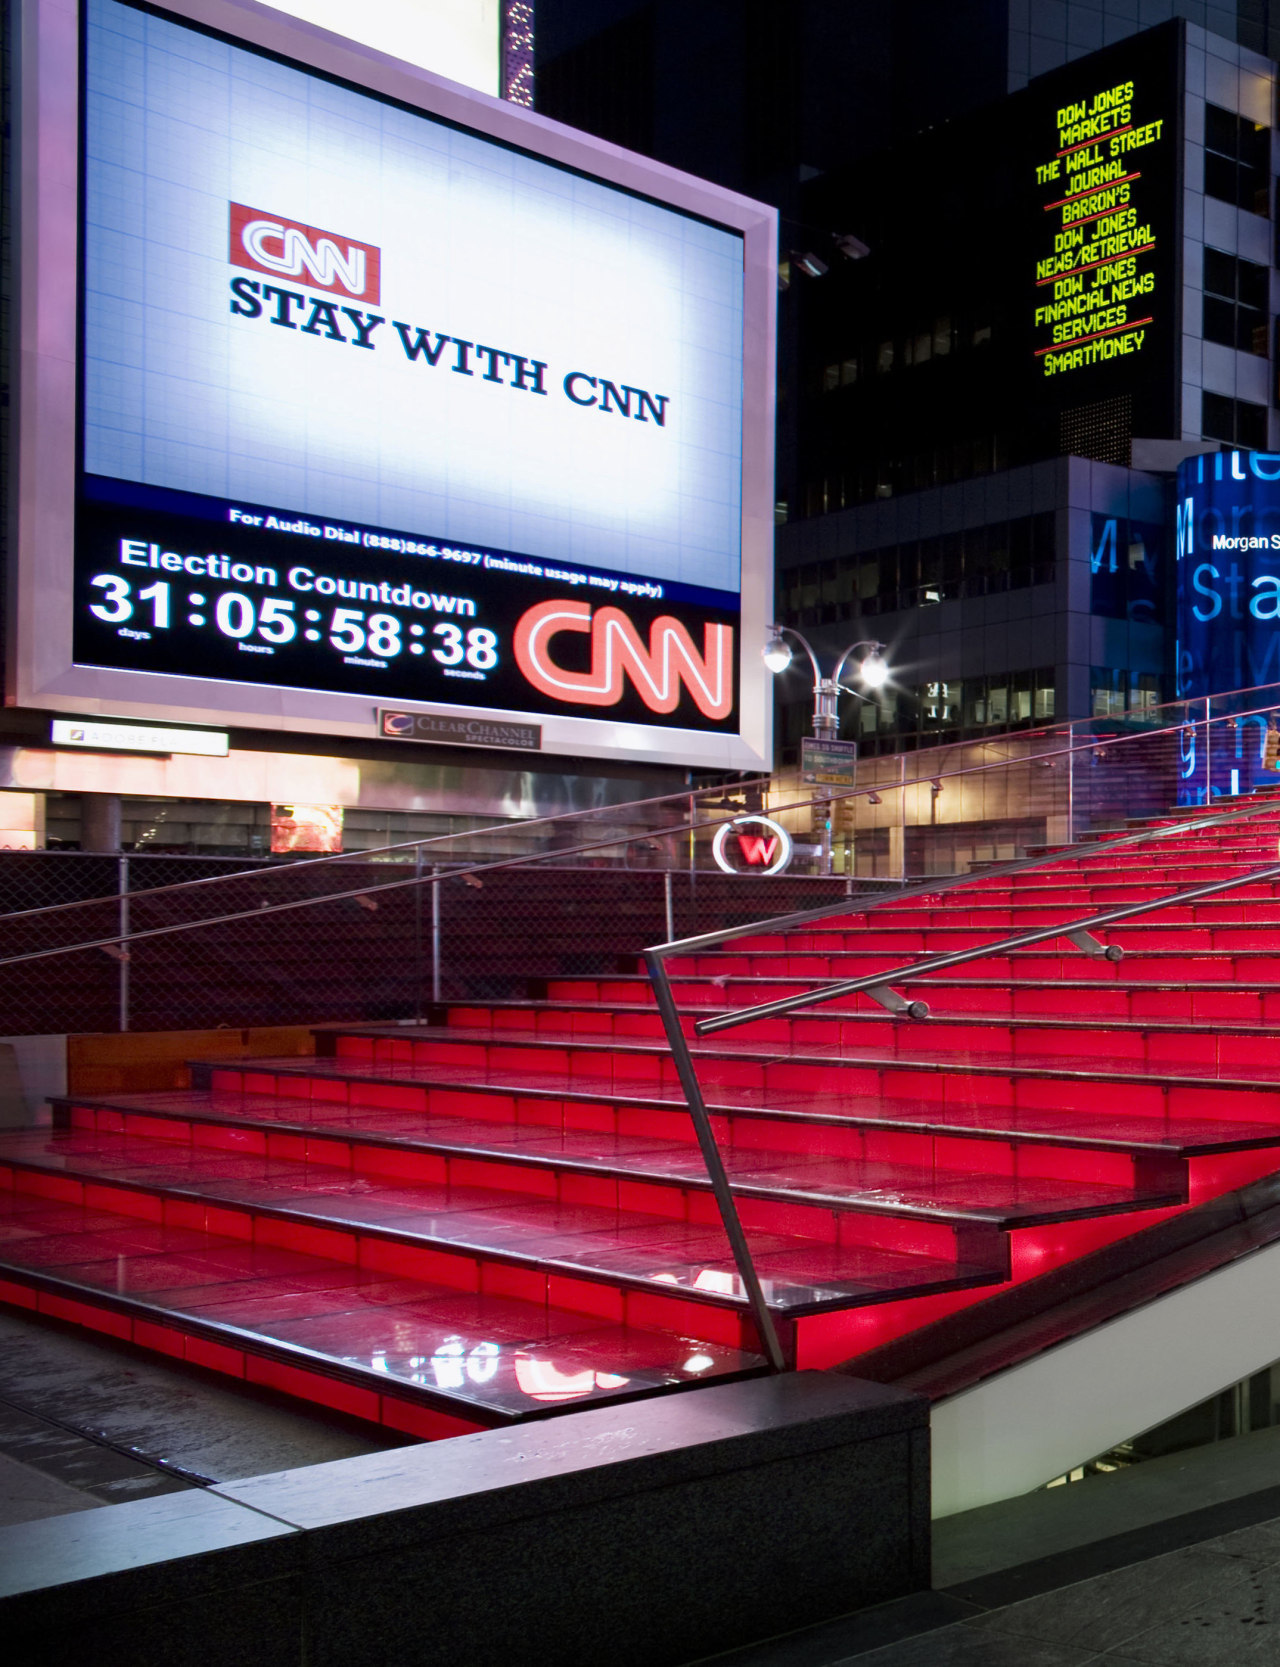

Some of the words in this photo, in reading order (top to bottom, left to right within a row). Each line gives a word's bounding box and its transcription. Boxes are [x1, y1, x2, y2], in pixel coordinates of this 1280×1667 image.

[1057, 100, 1086, 129] DOW
[1088, 81, 1134, 116] JONES
[1060, 104, 1131, 148] MARKETS
[1036, 160, 1061, 185] THE
[1066, 145, 1104, 174] WALL
[1110, 120, 1163, 157] STREET
[1065, 159, 1127, 196] JOURNAL
[1062, 183, 1130, 224] BARRON'S
[1036, 224, 1156, 280] NEWS/RETRIEVAL
[1055, 226, 1084, 253] DOW
[1091, 208, 1137, 240] JONES
[241, 220, 366, 295] CNN
[1054, 274, 1083, 300] DOW
[1091, 257, 1136, 288] JONES
[1035, 289, 1110, 327] FINANCIAL
[1111, 272, 1154, 303] NEWS
[1053, 304, 1127, 343] SERVICES
[229, 276, 385, 350] STAY
[392, 320, 548, 396] WITH
[562, 371, 670, 427] CNN
[228, 508, 262, 527] For
[264, 515, 321, 538] Audio
[324, 525, 360, 544] Dial
[363, 531, 482, 565] (888)866-9697
[484, 554, 543, 577] (minute
[544, 566, 588, 585] usage
[590, 573, 618, 592] may
[618, 580, 663, 599] apply)
[1212, 535, 1269, 552] Morgan
[120, 538, 278, 587] Election
[287, 567, 476, 616] Countdown
[118, 627, 151, 641] days
[238, 641, 274, 655] hours
[343, 656, 388, 669] minutes
[443, 668, 486, 681] seconds
[513, 599, 733, 720] CNN
[465, 734, 534, 747] SPECTACOLOR
[736, 835, 779, 866] W
